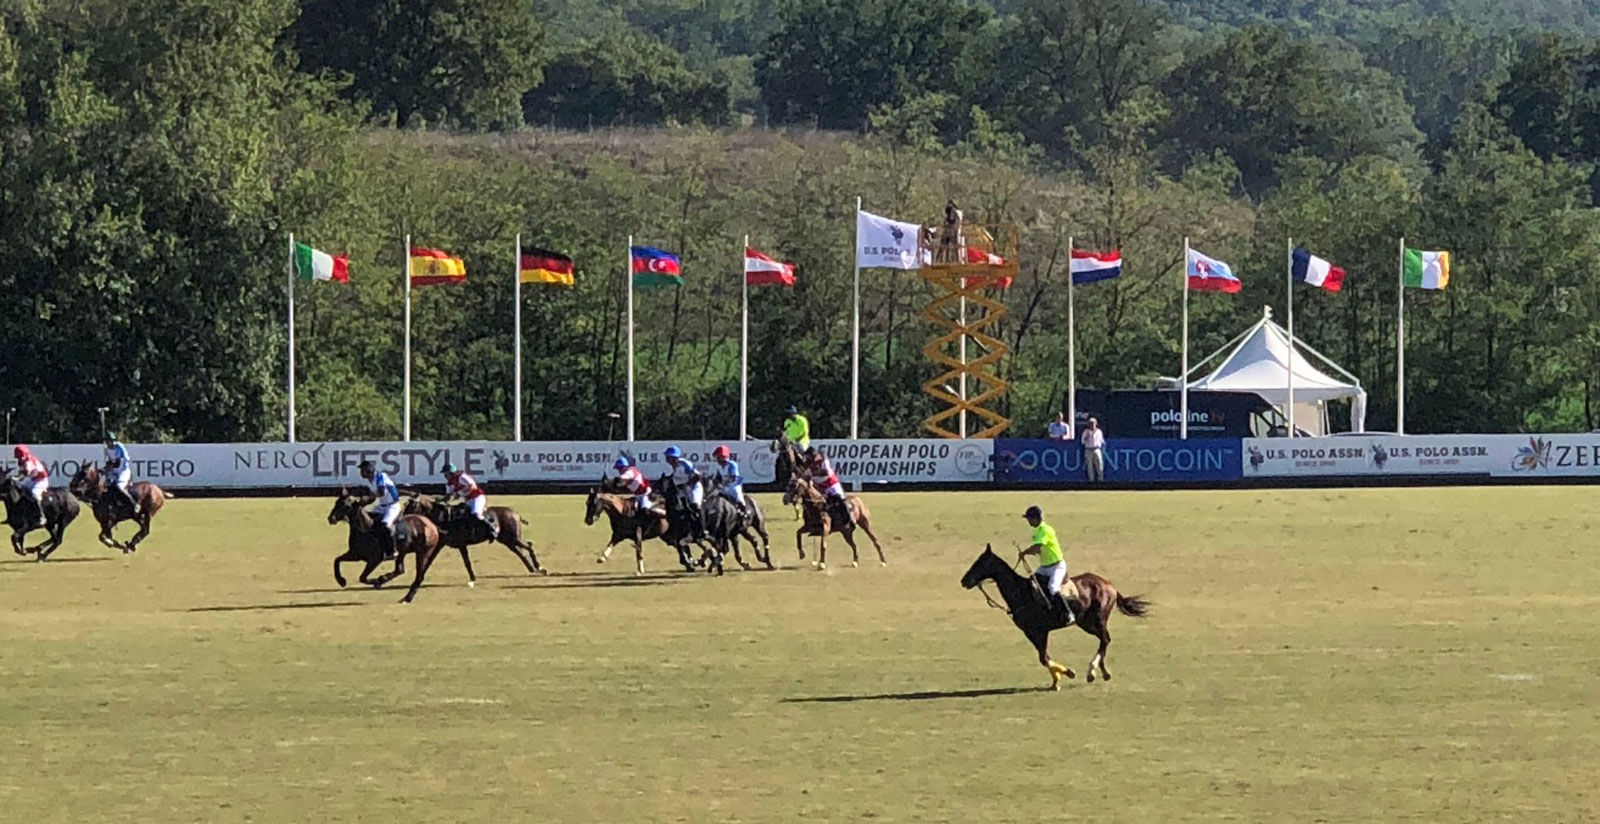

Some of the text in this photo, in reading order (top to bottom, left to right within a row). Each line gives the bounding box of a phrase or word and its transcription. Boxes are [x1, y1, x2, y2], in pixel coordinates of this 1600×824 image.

[1151, 409, 1209, 424] poloine
[907, 443, 949, 459] POLO
[1266, 448, 1366, 460] U.S. POLO ASSN.
[1390, 446, 1489, 458] U.S. POLO ASSN.
[537, 452, 573, 464] POLO
